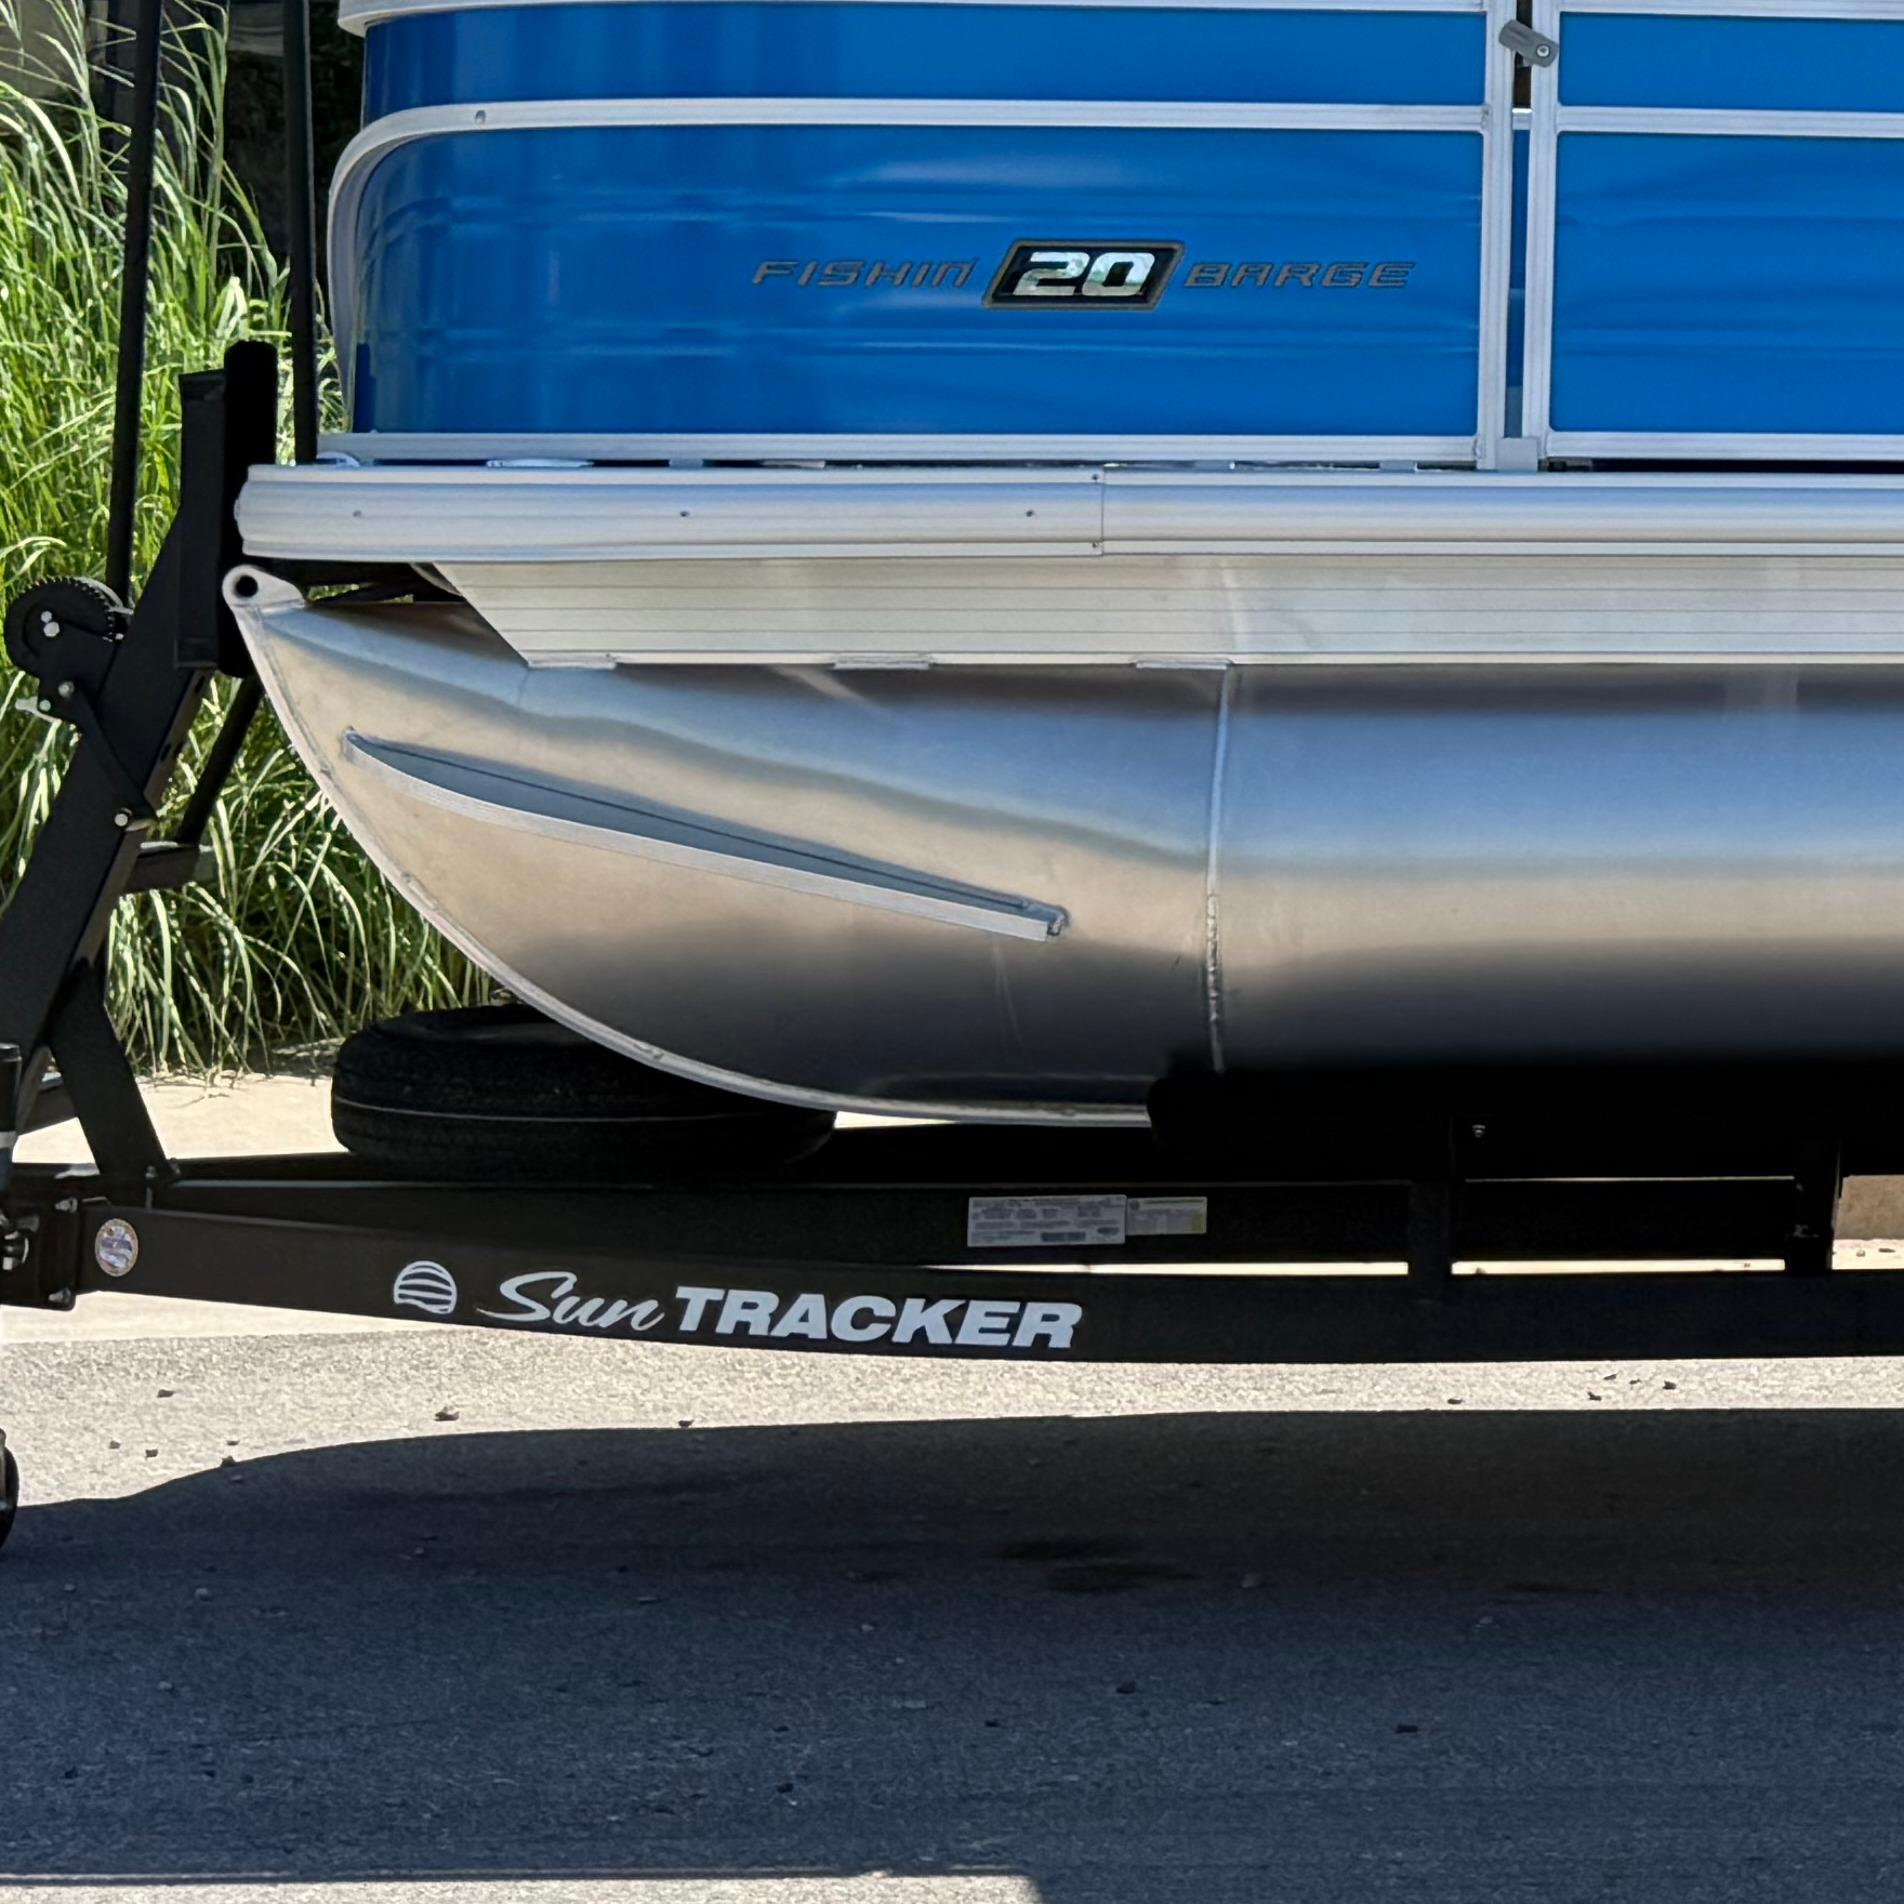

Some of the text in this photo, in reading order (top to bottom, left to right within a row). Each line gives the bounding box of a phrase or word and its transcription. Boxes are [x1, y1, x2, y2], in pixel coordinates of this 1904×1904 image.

[1012, 251, 1156, 296] 20
[1184, 261, 1415, 289] BARGE
[476, 1270, 1083, 1349] Sun TRACKER
